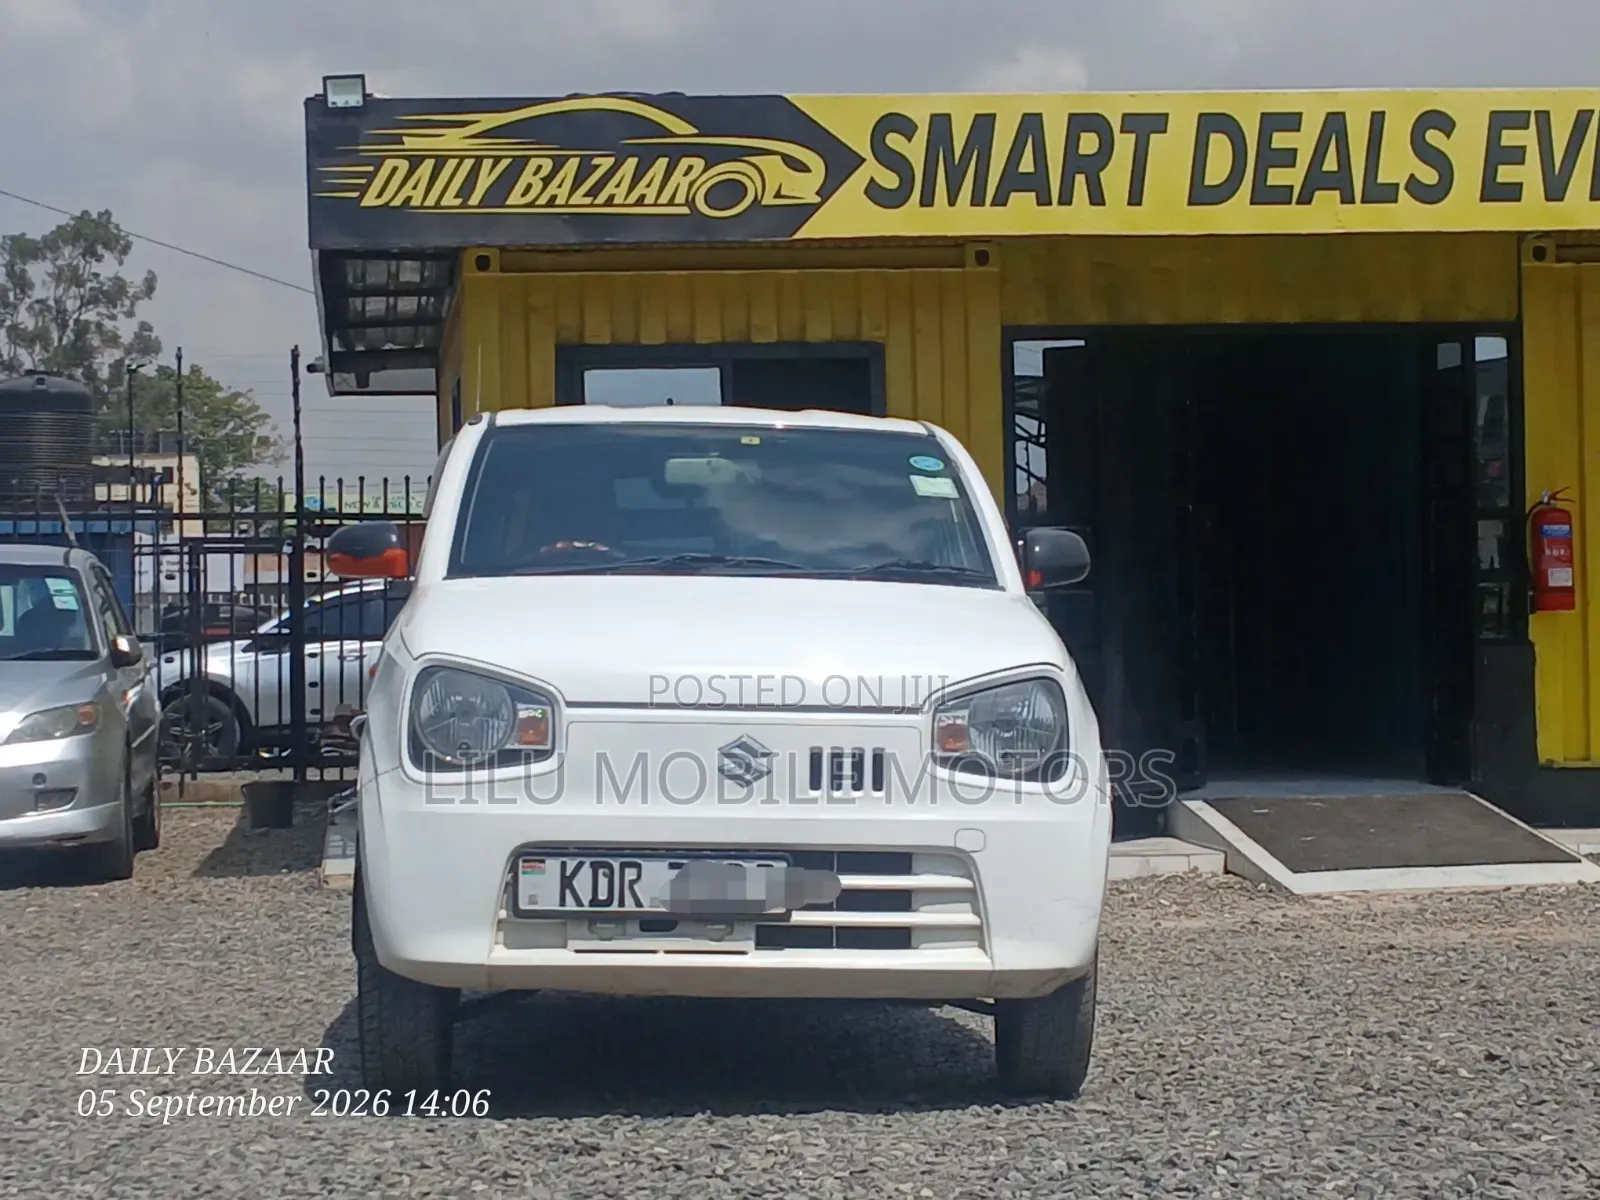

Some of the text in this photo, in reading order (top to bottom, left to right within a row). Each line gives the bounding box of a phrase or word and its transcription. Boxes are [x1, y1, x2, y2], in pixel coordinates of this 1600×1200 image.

[360, 157, 704, 207] DAILY BAZAAR
[864, 108, 1600, 209] SMART DEALS EV
[559, 859, 645, 909] KDR
